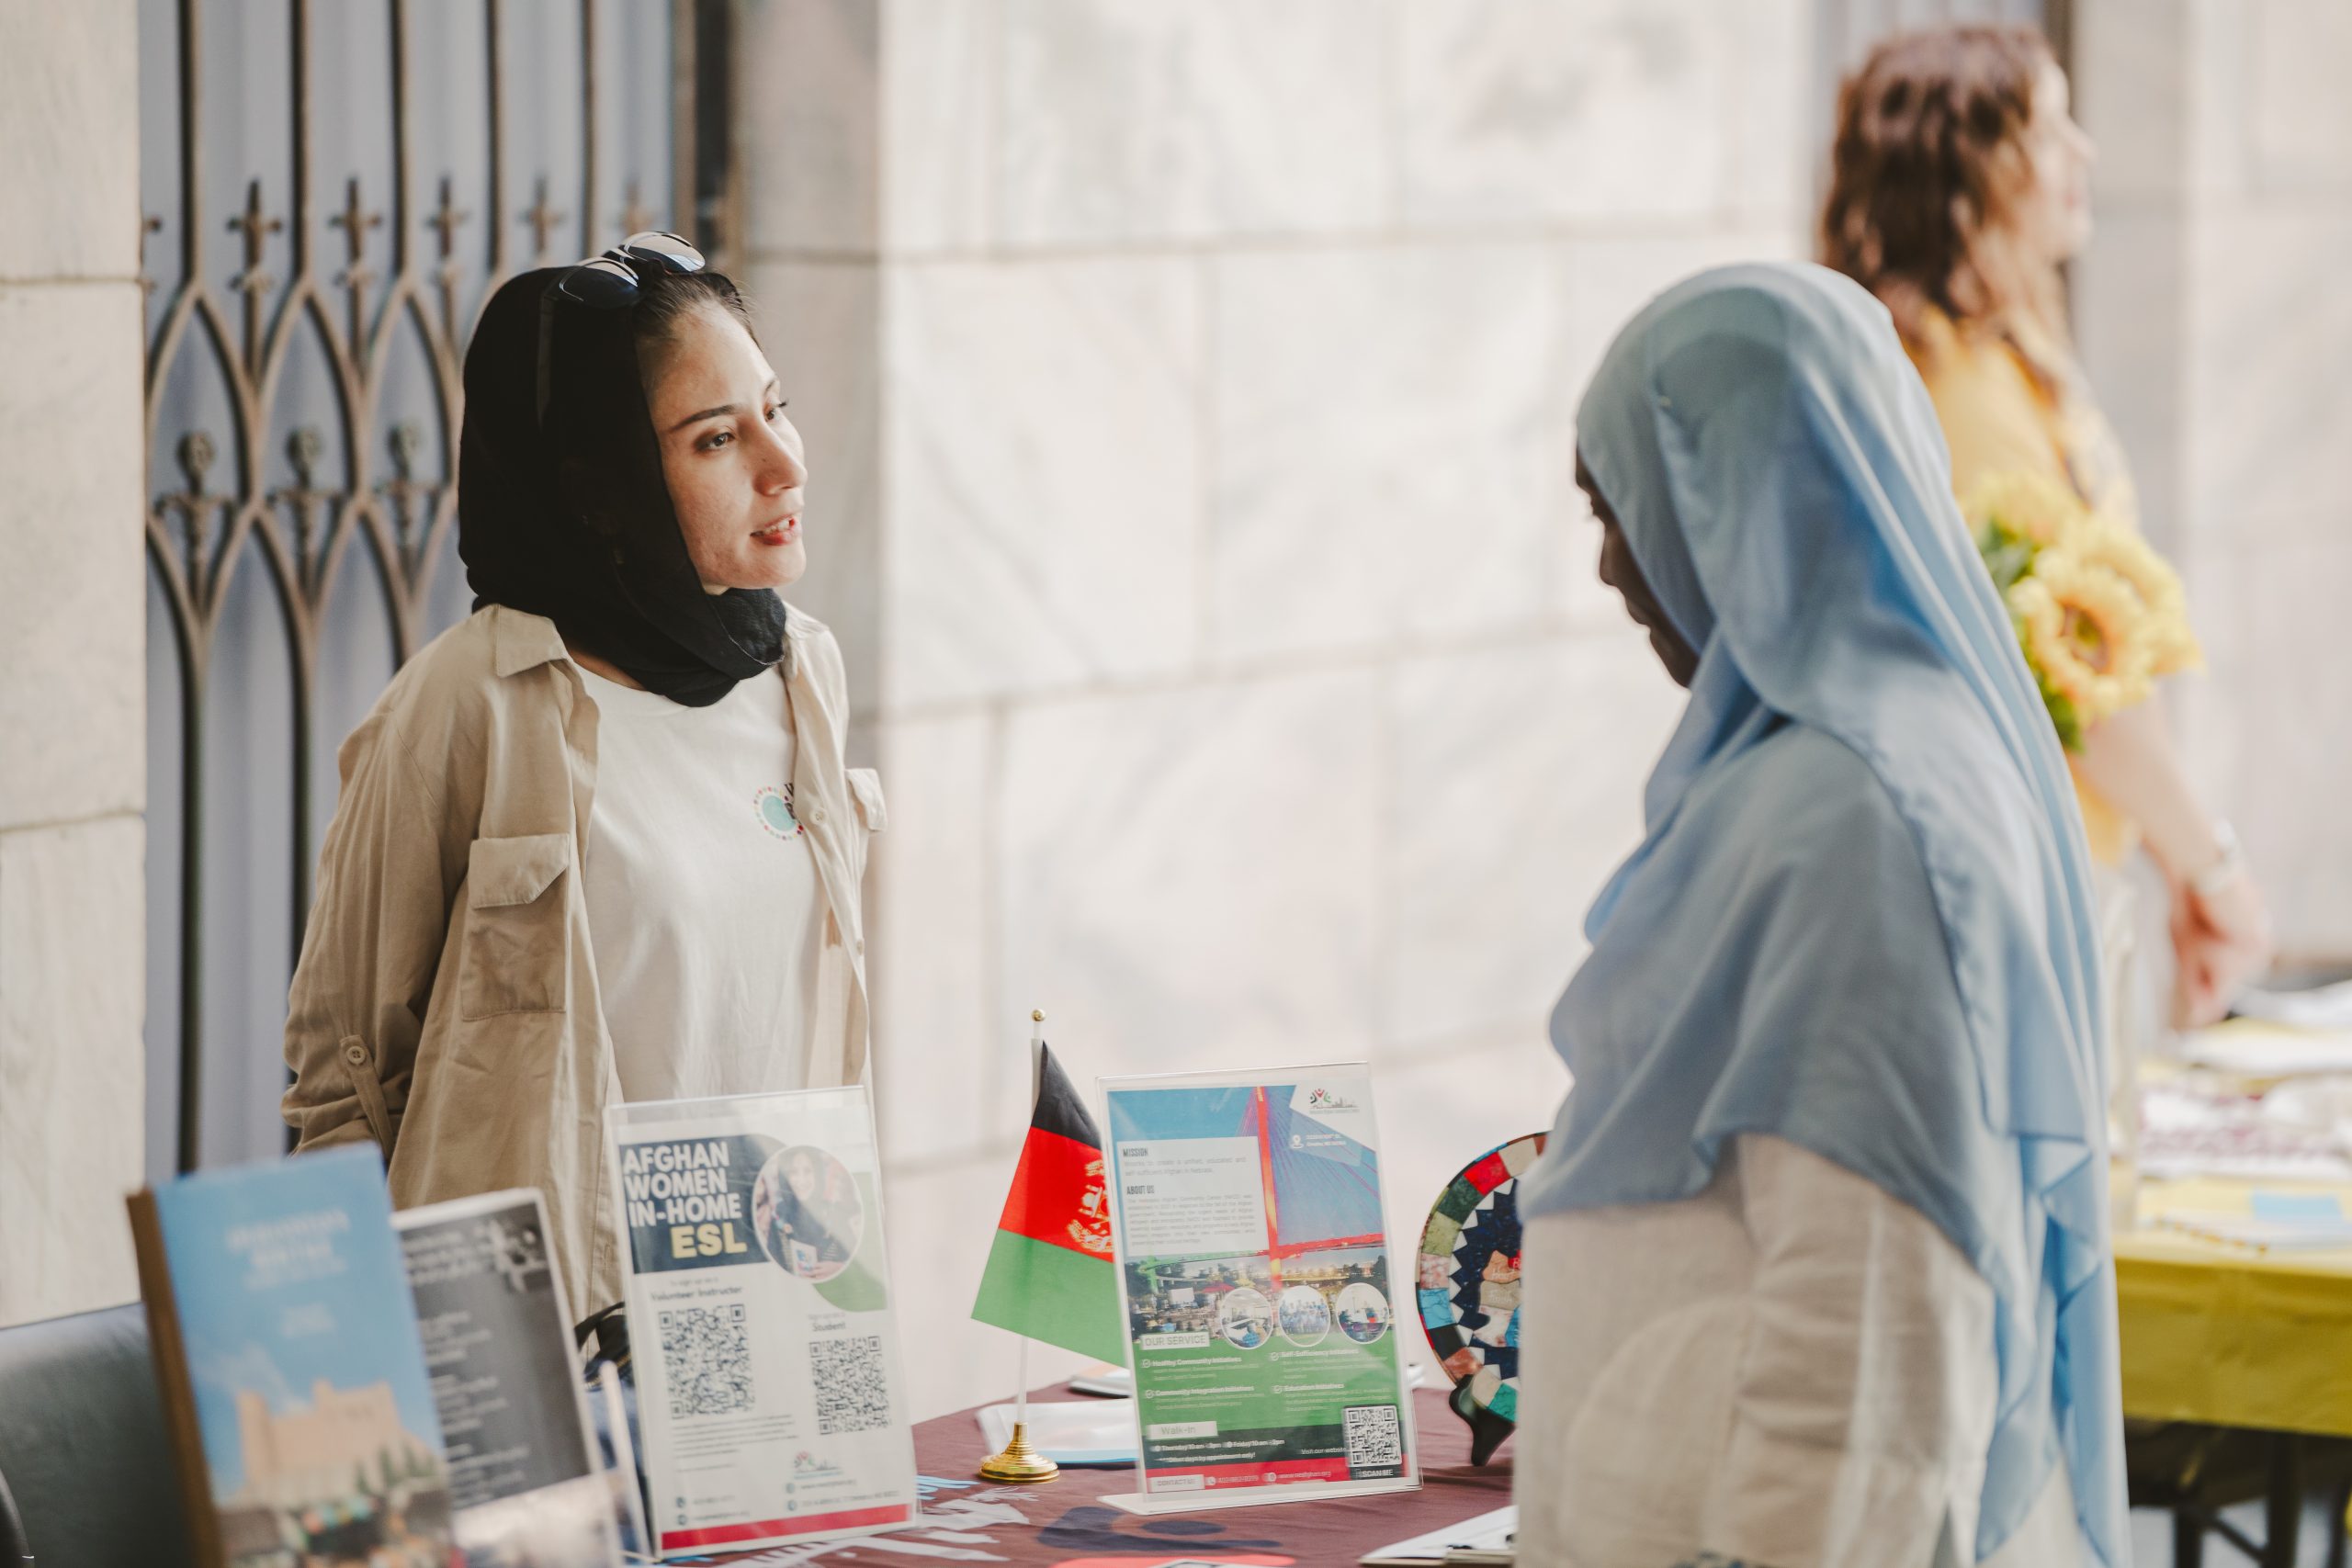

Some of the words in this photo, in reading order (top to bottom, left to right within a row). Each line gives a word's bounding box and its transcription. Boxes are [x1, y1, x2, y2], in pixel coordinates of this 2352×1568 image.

[623, 1141, 730, 1175] AFGHAN
[1123, 1148, 1148, 1157] MISSION
[624, 1168, 728, 1201] WOMEN
[1126, 1186, 1146, 1195] ABOUT
[1147, 1185, 1155, 1194] US
[628, 1192, 742, 1228] IN-HOME
[670, 1222, 748, 1259] ESL
[1146, 1337, 1165, 1346] OUR
[1167, 1335, 1206, 1346] SERVICE
